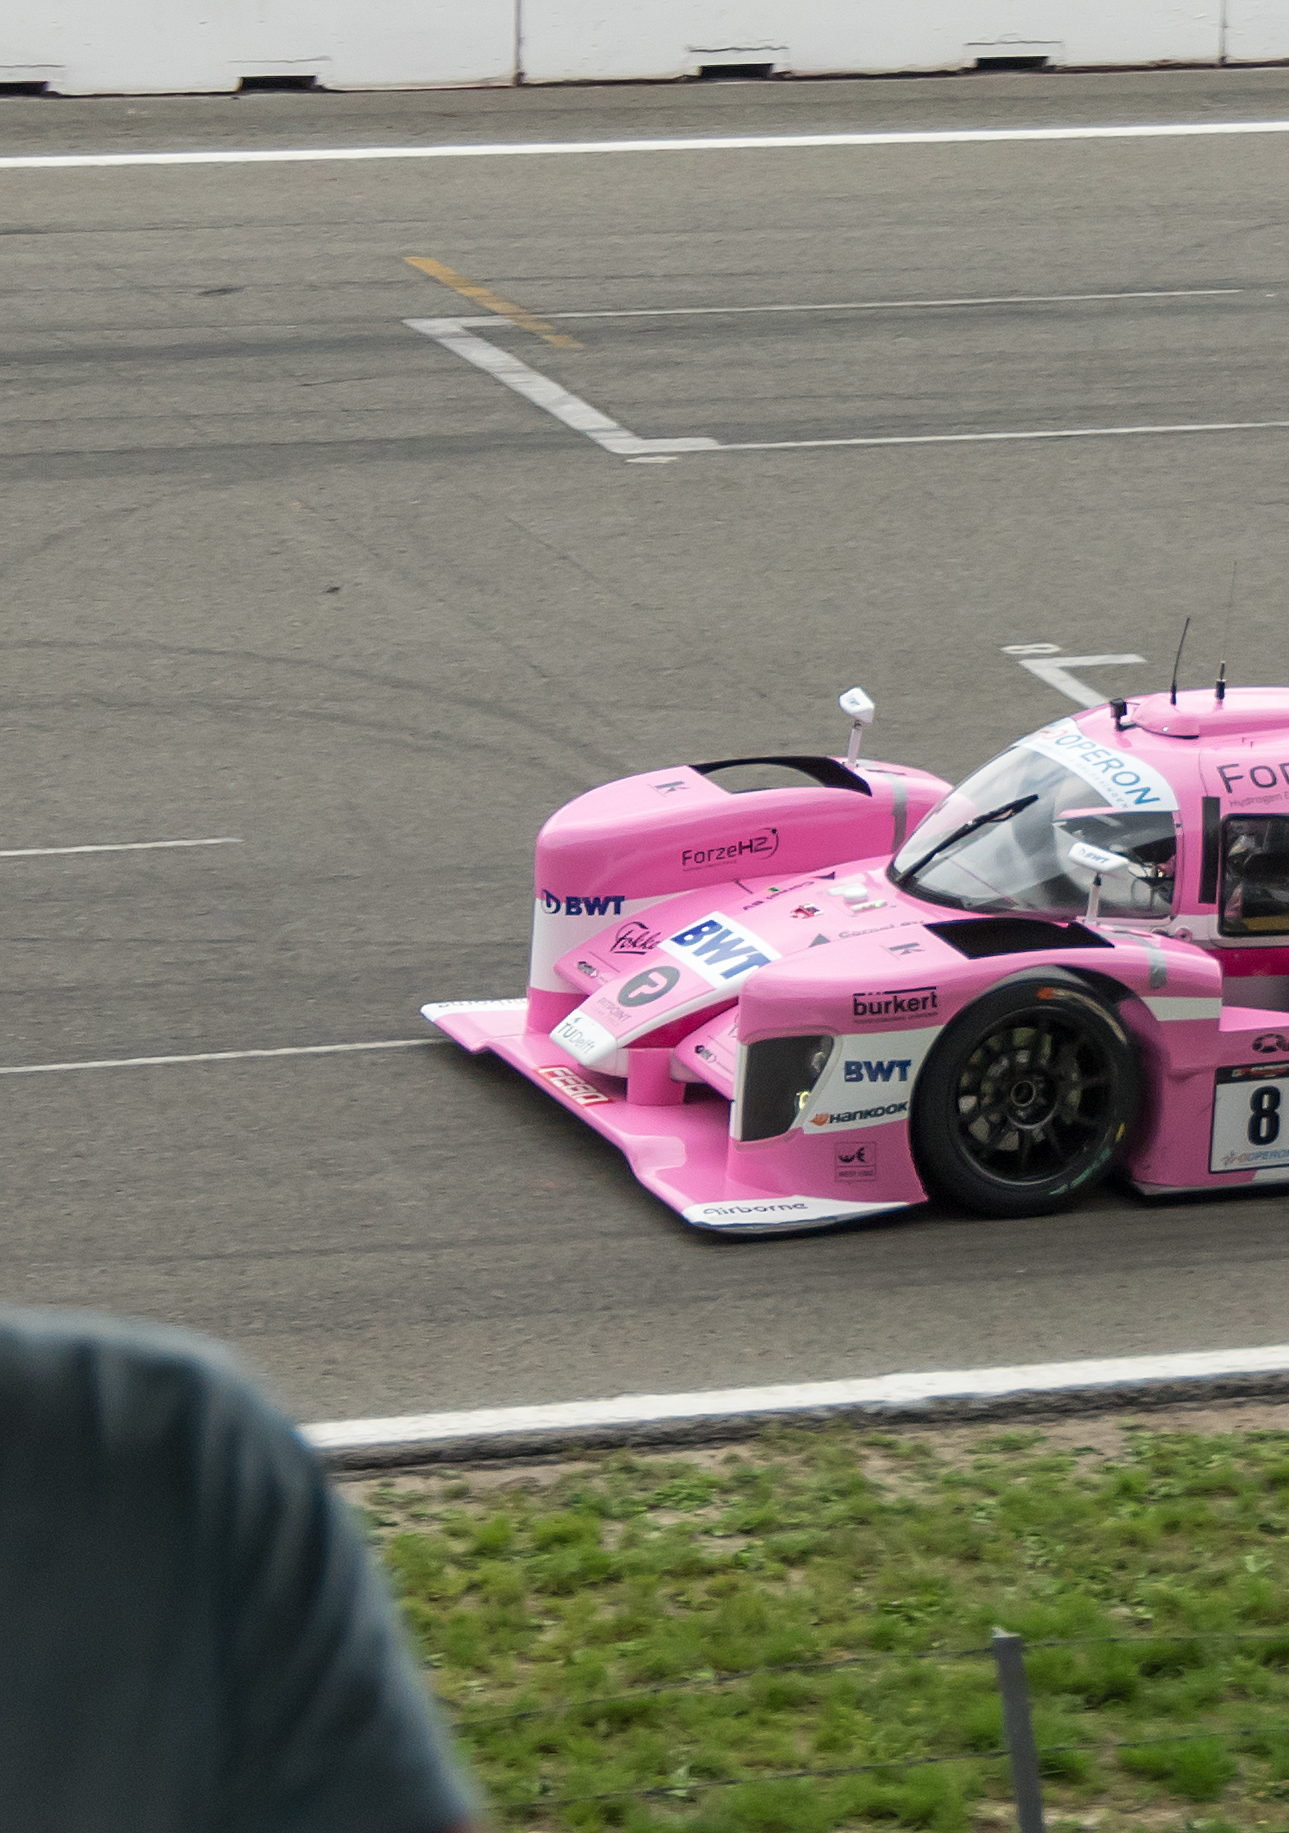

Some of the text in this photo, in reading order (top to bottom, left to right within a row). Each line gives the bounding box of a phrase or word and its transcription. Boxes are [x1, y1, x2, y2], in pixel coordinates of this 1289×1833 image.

[1230, 794, 1282, 808] Hydrogen
[682, 835, 773, 866] ForzeH2
[565, 896, 625, 916] BWT
[669, 919, 771, 980] BWT
[844, 1059, 911, 1082] BWT
[1248, 1085, 1281, 1145] 8
